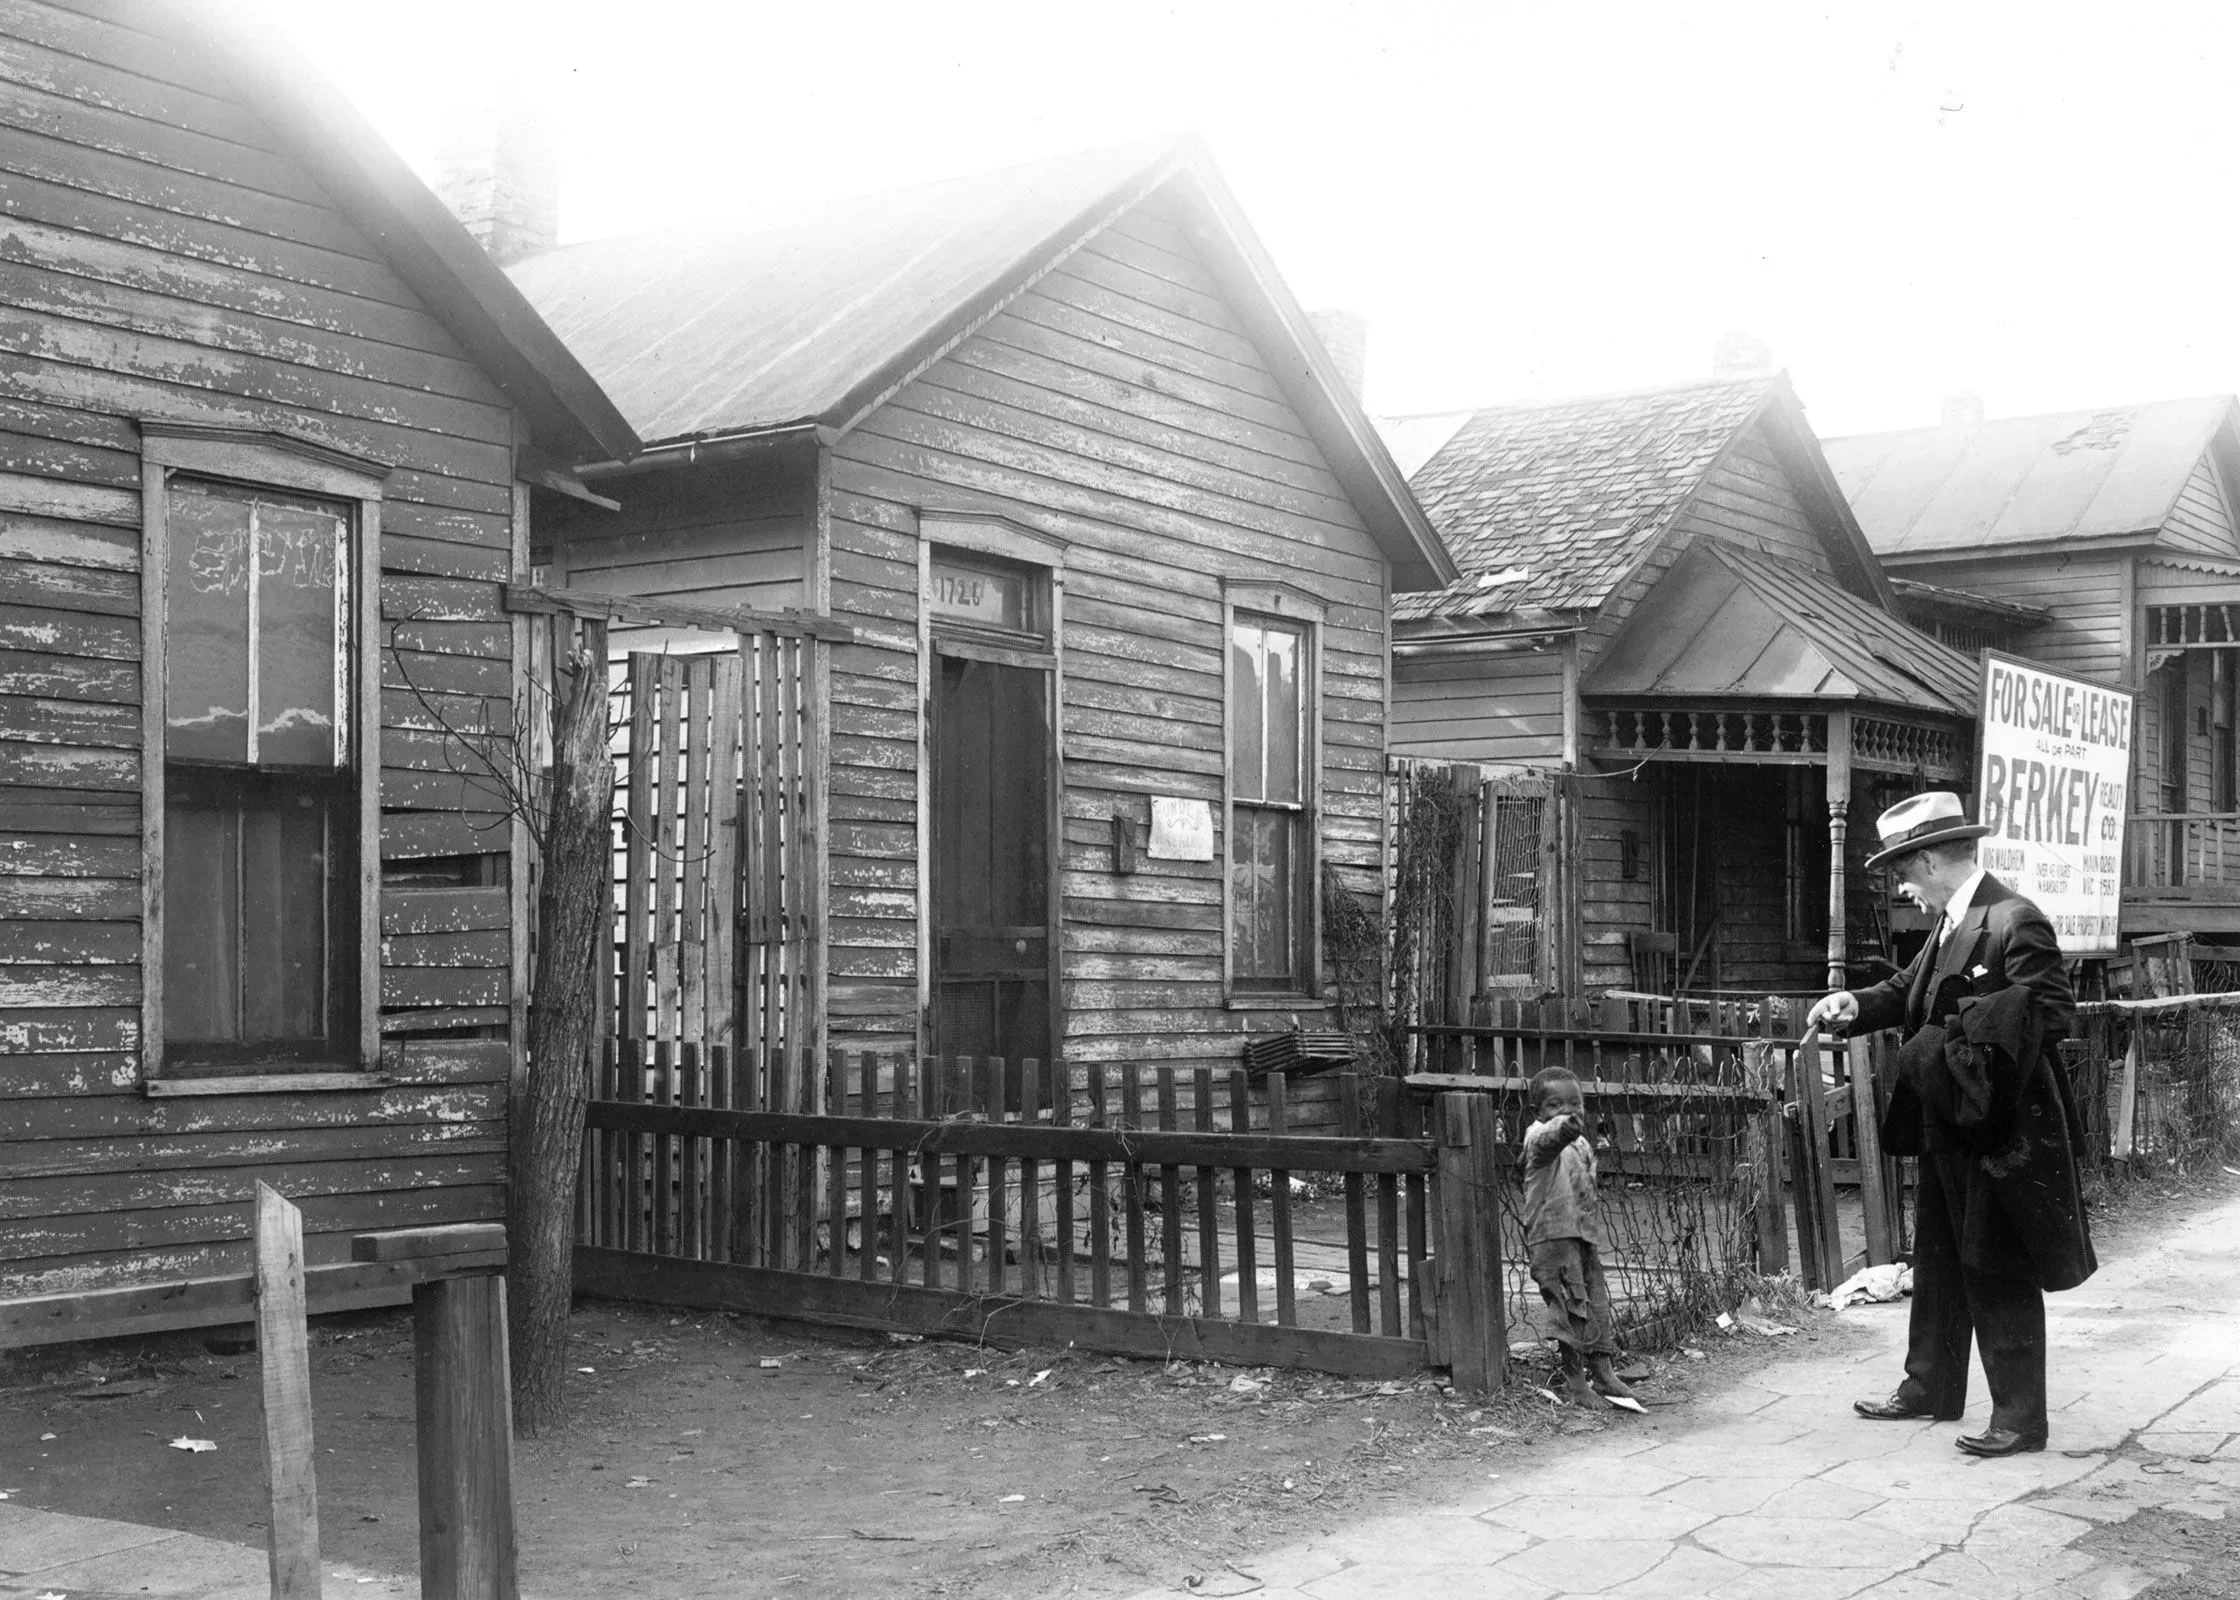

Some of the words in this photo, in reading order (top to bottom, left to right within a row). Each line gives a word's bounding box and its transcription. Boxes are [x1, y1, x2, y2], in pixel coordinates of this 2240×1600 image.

[1990, 667, 2028, 729] FOR
[2028, 677, 2074, 739] SALE
[2072, 703, 2081, 726] OR
[2080, 690, 2129, 750] LEASE
[2035, 739, 2050, 754] ALL
[2064, 744, 2087, 760] PART
[1984, 753, 2100, 846] BERKEY
[2101, 815, 2117, 842] CO.
[2083, 855, 2098, 873] MAIN
